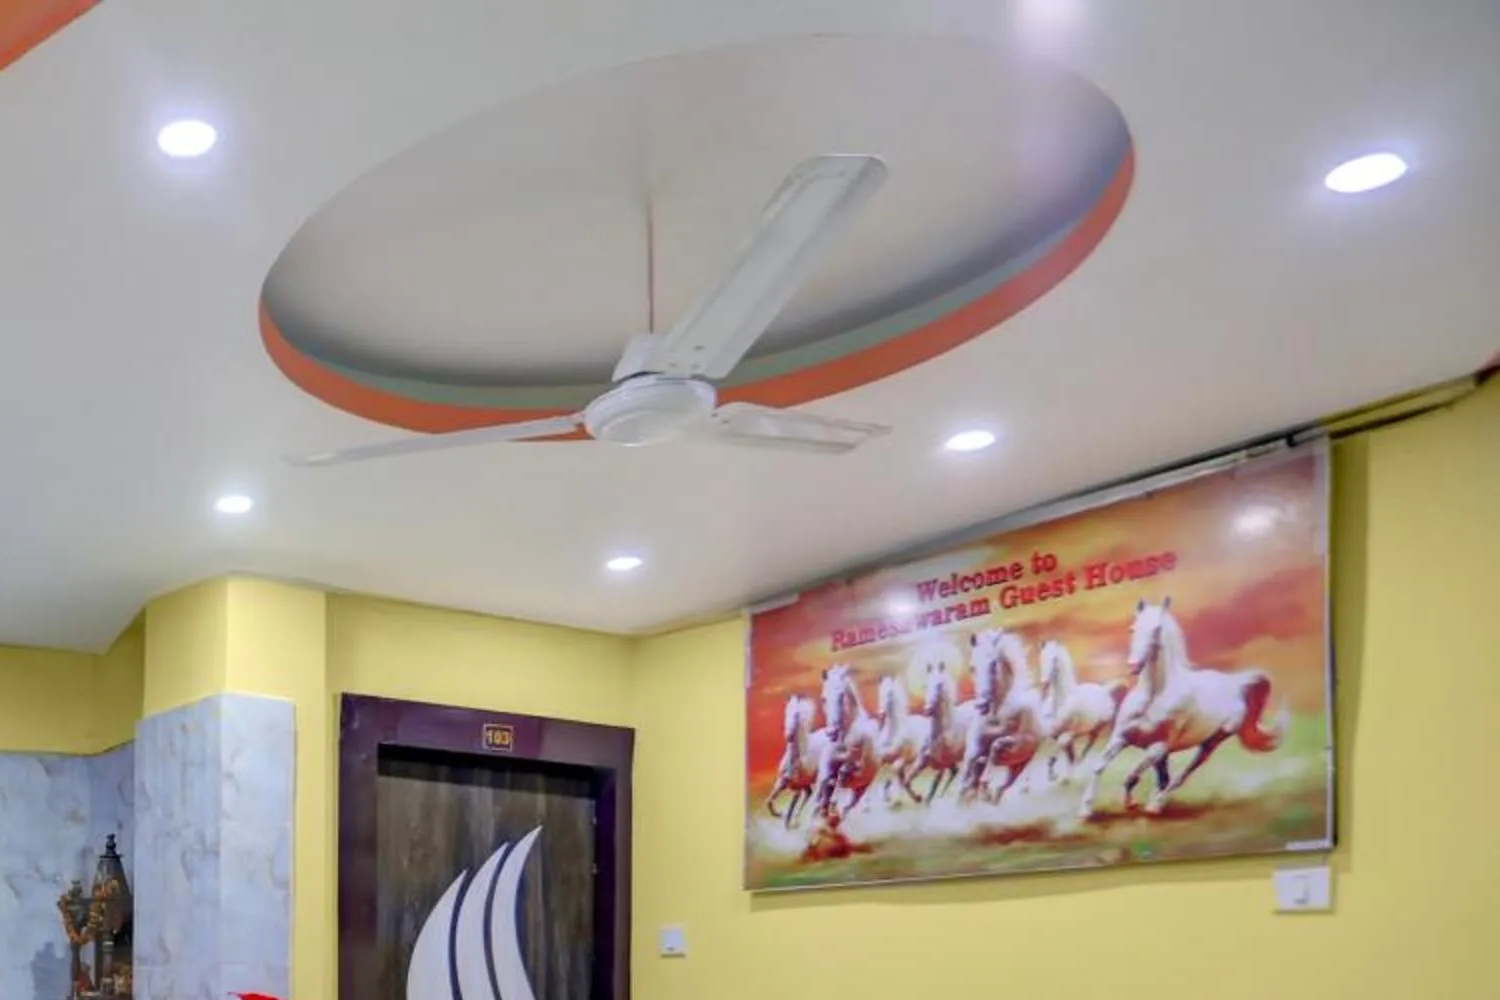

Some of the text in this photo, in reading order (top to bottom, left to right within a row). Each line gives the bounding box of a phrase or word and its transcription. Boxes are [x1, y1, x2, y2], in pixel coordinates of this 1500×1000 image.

[831, 551, 1177, 652] Rameswaram Guest House
[916, 549, 1058, 602] Welcome to
